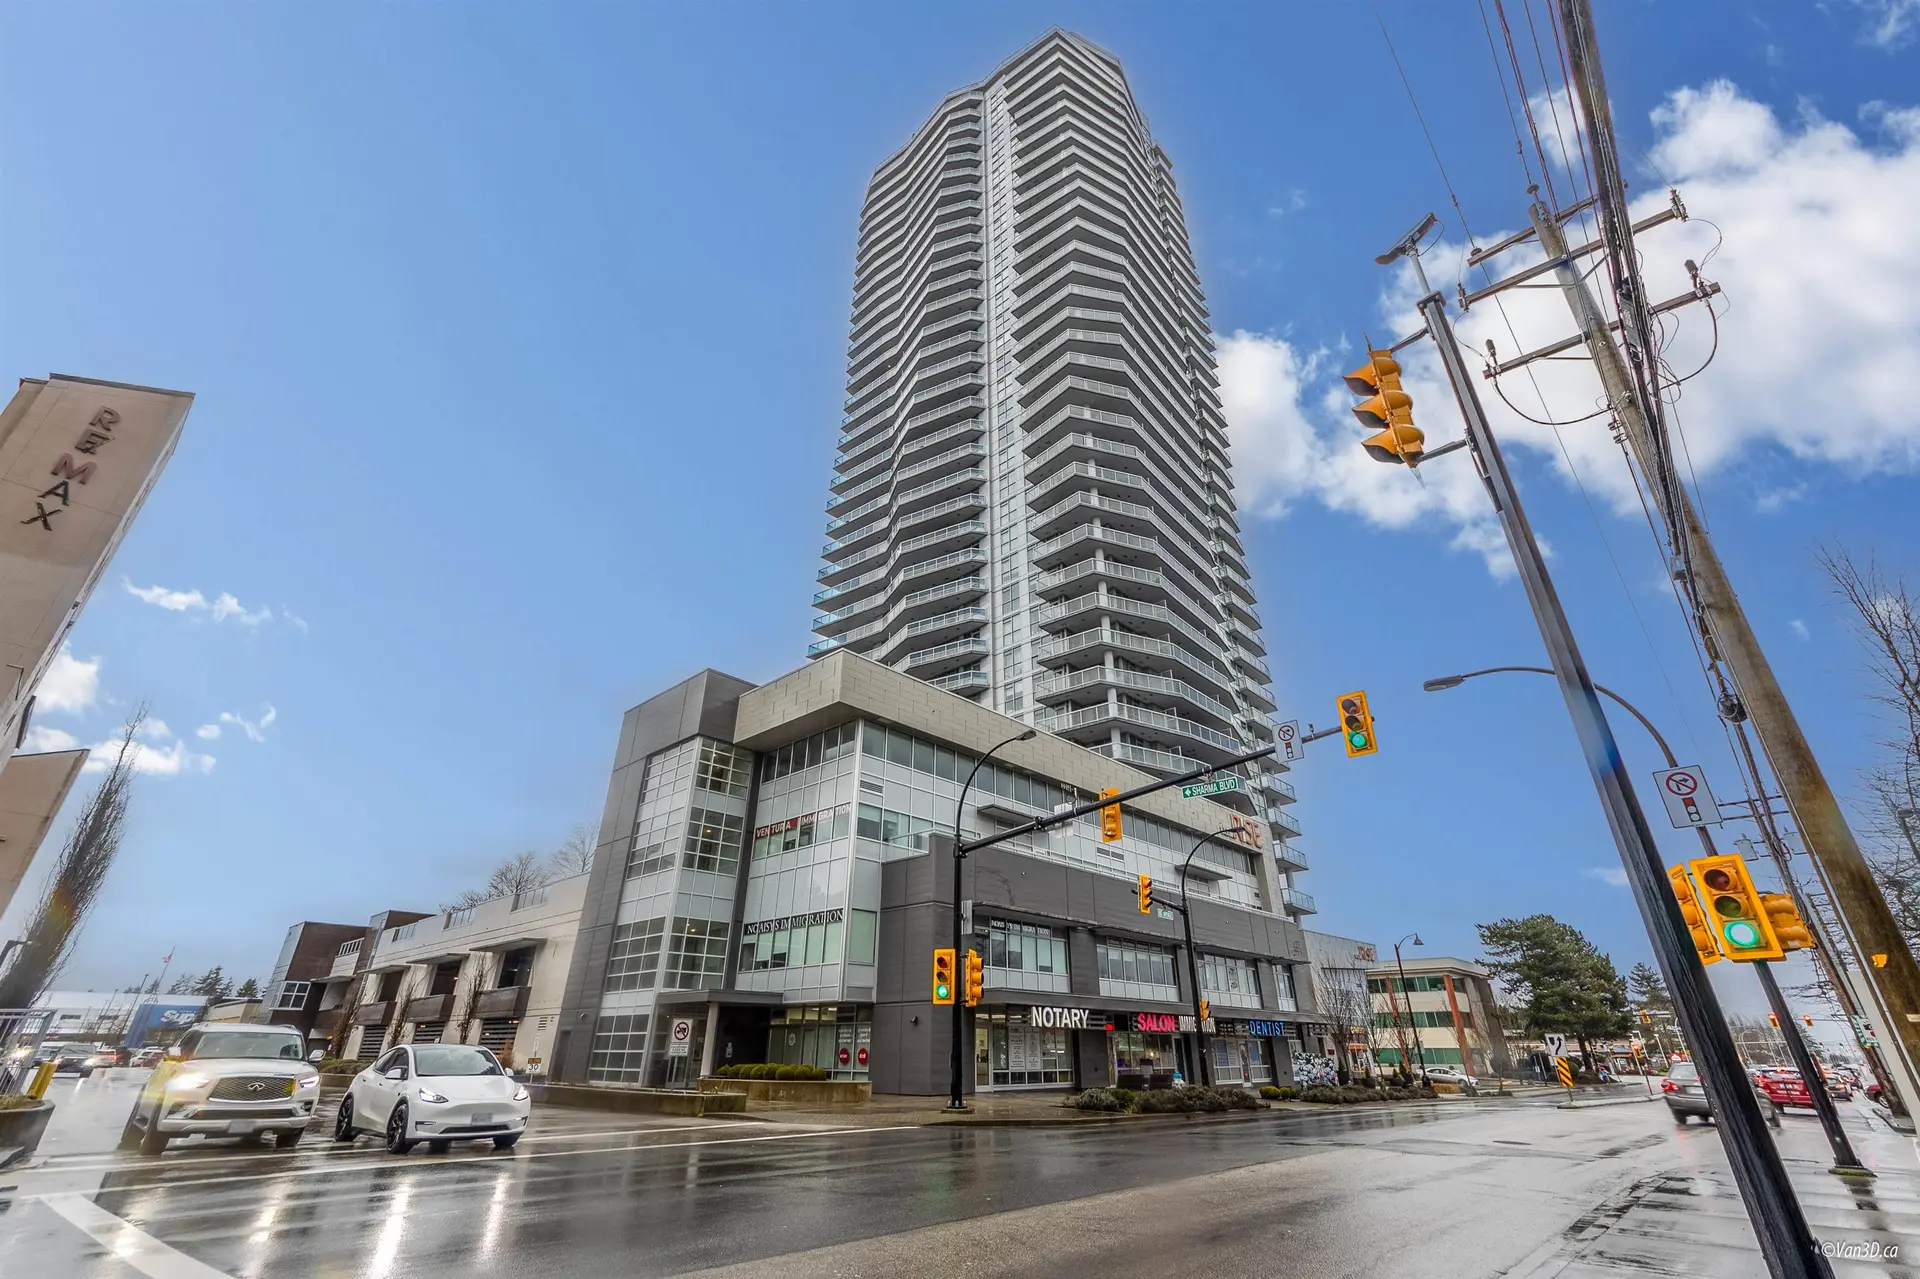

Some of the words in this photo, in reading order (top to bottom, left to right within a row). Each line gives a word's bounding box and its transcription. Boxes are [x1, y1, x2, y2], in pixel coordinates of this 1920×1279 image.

[1192, 785, 1218, 797] SHARMA
[1219, 779, 1236, 791] BLVD
[756, 821, 791, 838] VENTURA
[801, 804, 851, 825] IMMIGRATION
[780, 910, 843, 930] IMMIGRATION
[1031, 1006, 1090, 1029] NOTARY
[1137, 1011, 1176, 1033] SALON
[1250, 1020, 1285, 1037] DENTIST
